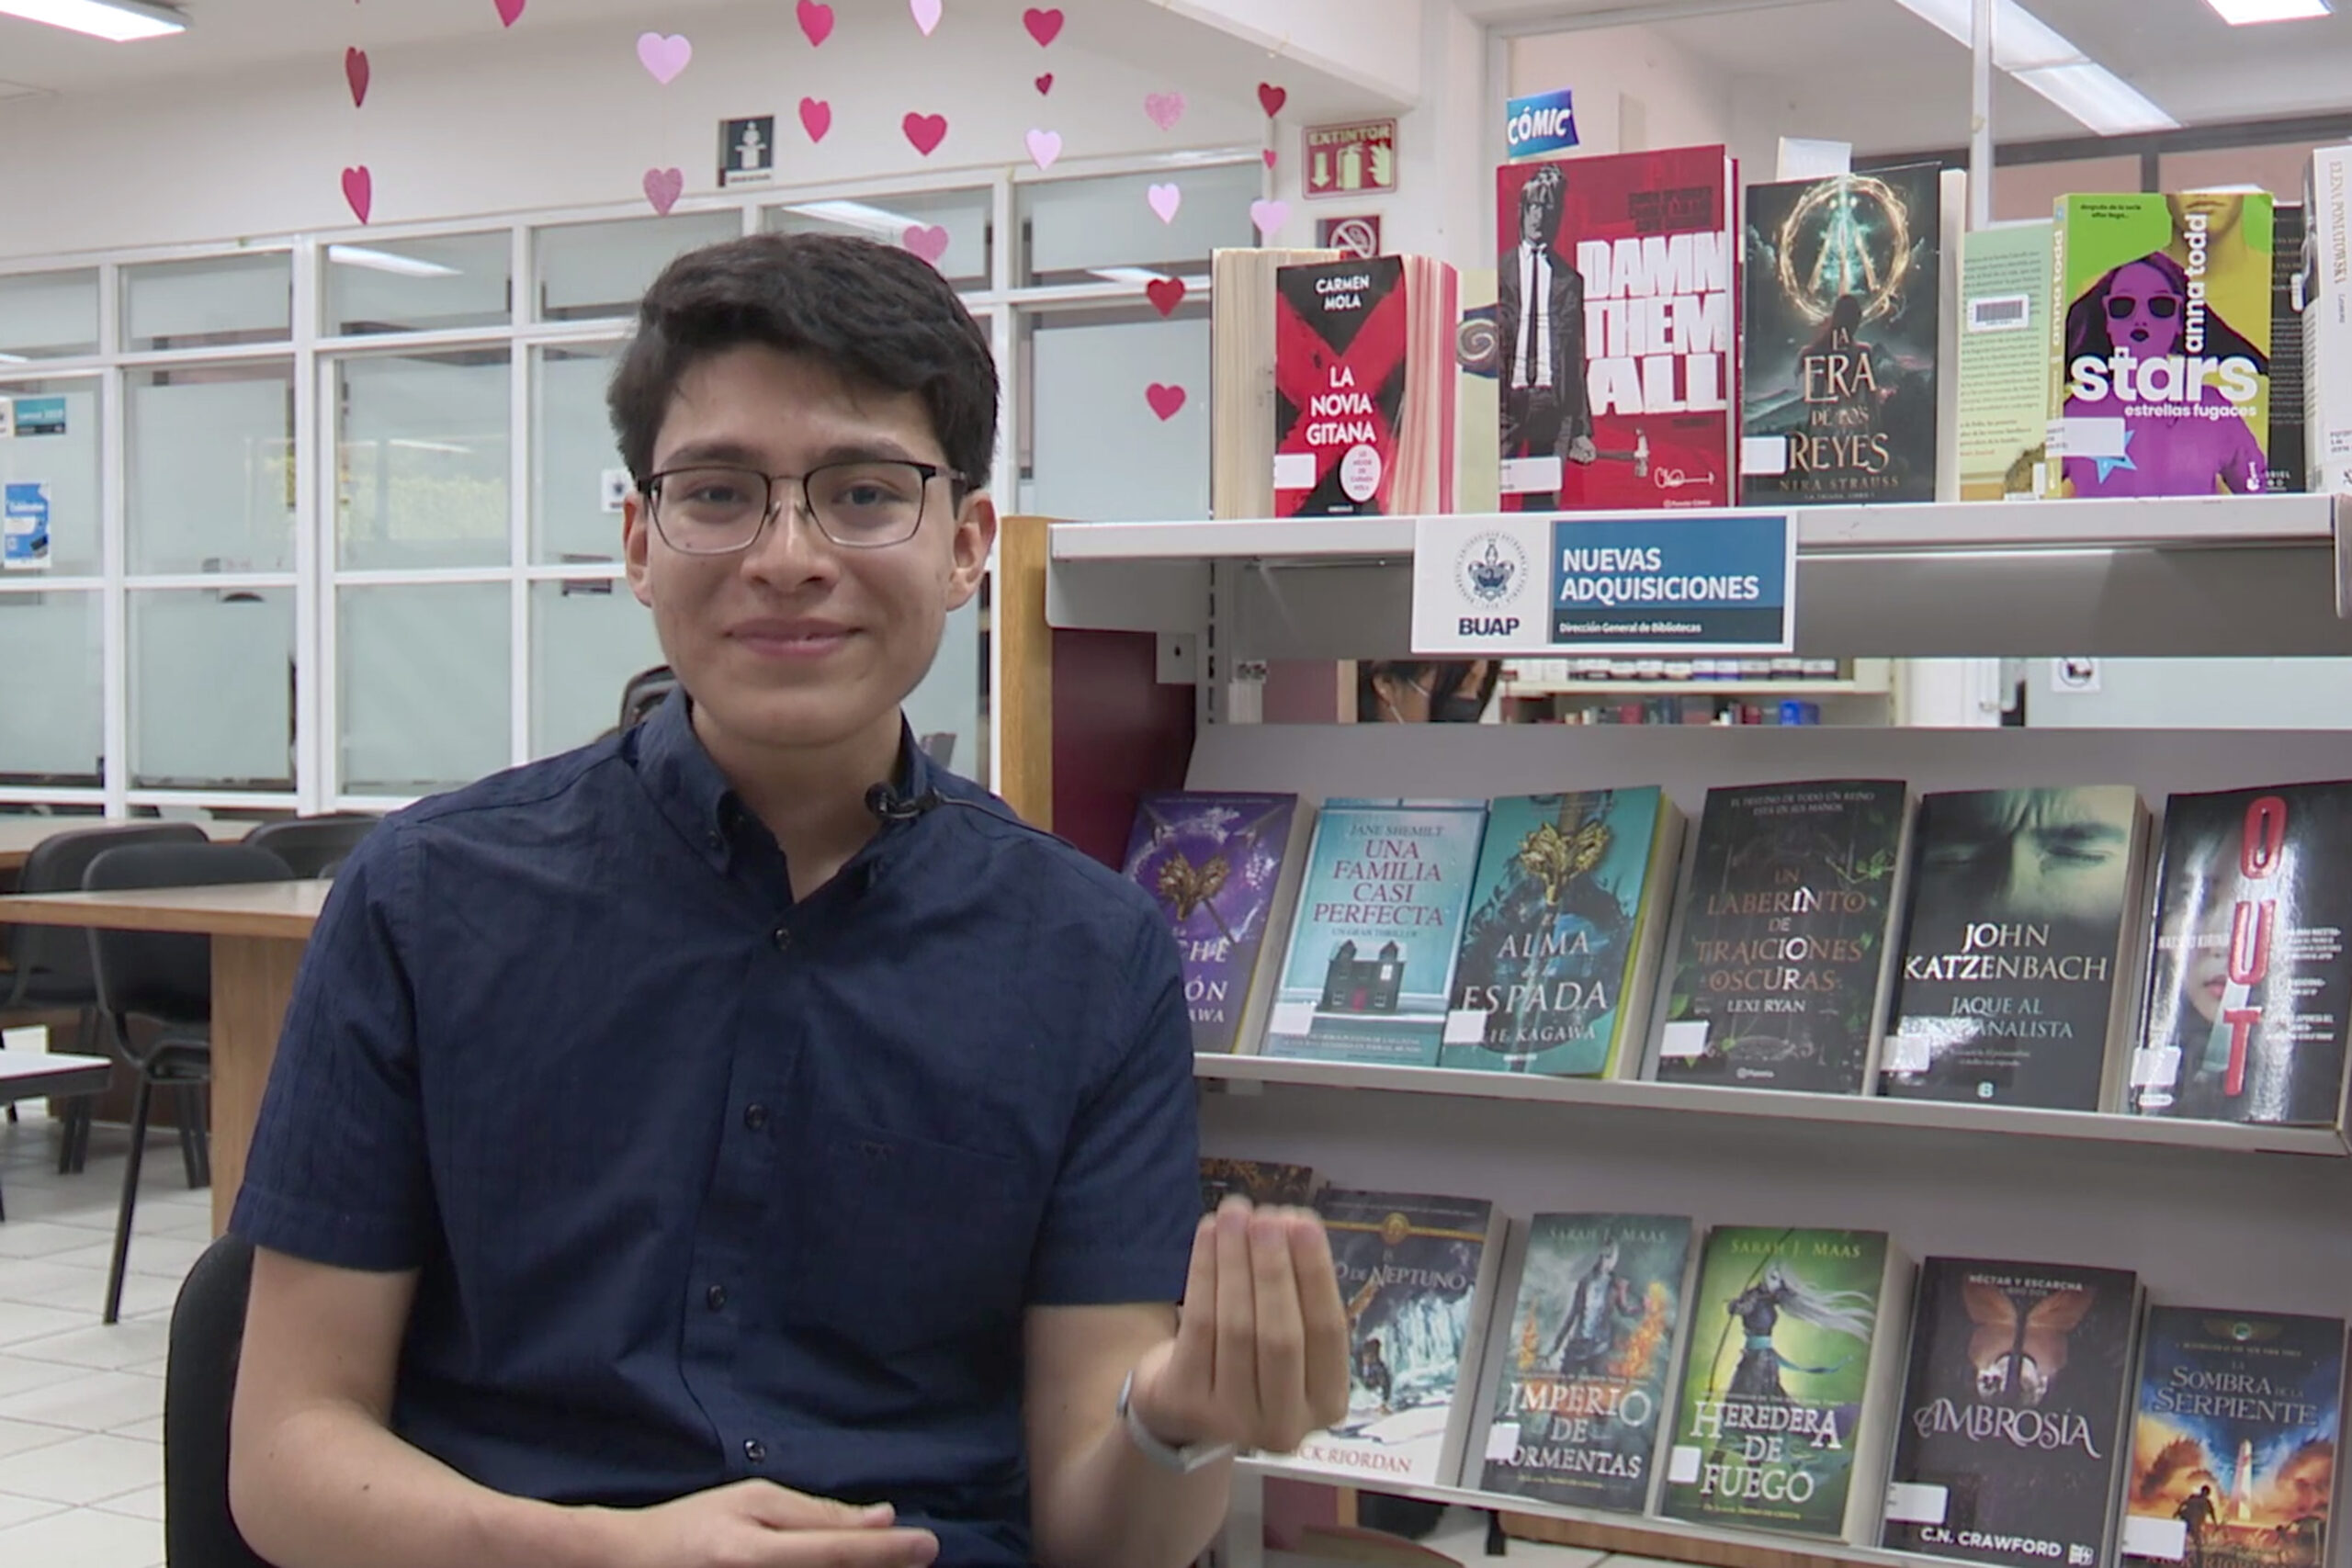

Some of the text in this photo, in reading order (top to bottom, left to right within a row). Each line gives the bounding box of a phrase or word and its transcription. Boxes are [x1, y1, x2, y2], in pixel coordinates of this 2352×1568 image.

[1308, 125, 1390, 146] EXTINTOR
[1508, 106, 1570, 144] CÓMIC
[1577, 231, 1725, 300] DAMN
[1316, 275, 1370, 293] CARMEN
[2184, 213, 2207, 353] anna todd
[1324, 294, 1361, 310] MOLA
[1584, 295, 1725, 358] THEM
[1831, 327, 1849, 351] LA
[1329, 366, 1355, 388] LA
[1587, 351, 1726, 416] ALL
[1804, 353, 1878, 404] ERA
[2070, 347, 2258, 401] stars
[1310, 393, 1373, 417] NOVIA
[2124, 403, 2256, 421] estrellas fugaces
[1306, 422, 1376, 446] GITANA
[1788, 431, 1890, 474] REYES
[1563, 547, 1661, 572] NUEVAS
[1560, 576, 1759, 606] ADQUISICIONES
[1459, 616, 1521, 636] BUAP
[1559, 621, 1702, 634] Dirección General de Bibliotecas
[1351, 825, 1443, 838] JANE SHEMILT
[1365, 840, 1419, 859] UNA
[1333, 860, 1442, 882] FAMILIA
[1775, 868, 1801, 884] UN
[1353, 883, 1414, 903] CASI
[1707, 886, 1867, 916] LABERINTO
[1313, 903, 1443, 926] PERFECTA
[1768, 917, 1791, 933] DE
[1497, 931, 1589, 959] ALMA
[1695, 936, 1863, 965] TRAICIONES
[1962, 923, 2051, 953] JOHN
[2223, 795, 2288, 1096] OUT
[1709, 965, 1838, 992] OSCURAS
[1903, 955, 2108, 982] KATZENBACH
[1462, 980, 1608, 1015] ESPADA
[1727, 998, 1805, 1014] LEXI RYAN
[1951, 996, 2044, 1017] JAQUE AL
[1517, 1025, 1596, 1042] KAGAWA
[1813, 1242, 1861, 1258] MAAS
[1371, 1263, 1467, 1290] NEPTUNO
[1969, 1273, 2083, 1292] NÉCTAR Y ESCARCHA
[2170, 1365, 2272, 1395] SOMBRA
[1505, 1382, 1652, 1427] IMPERIO
[2154, 1387, 2318, 1427] SERPIENTE
[1550, 1416, 1589, 1443] DE
[1690, 1401, 1842, 1450] HEREDERA
[1913, 1397, 2101, 1459] AMBROSÍA
[1328, 1447, 1412, 1473] RIORDAN
[1744, 1435, 1783, 1462] DE
[1701, 1464, 1815, 1504] FUEGO
[1920, 1527, 1954, 1545] C.N.
[1958, 1531, 2063, 1558] CRAWFORD
